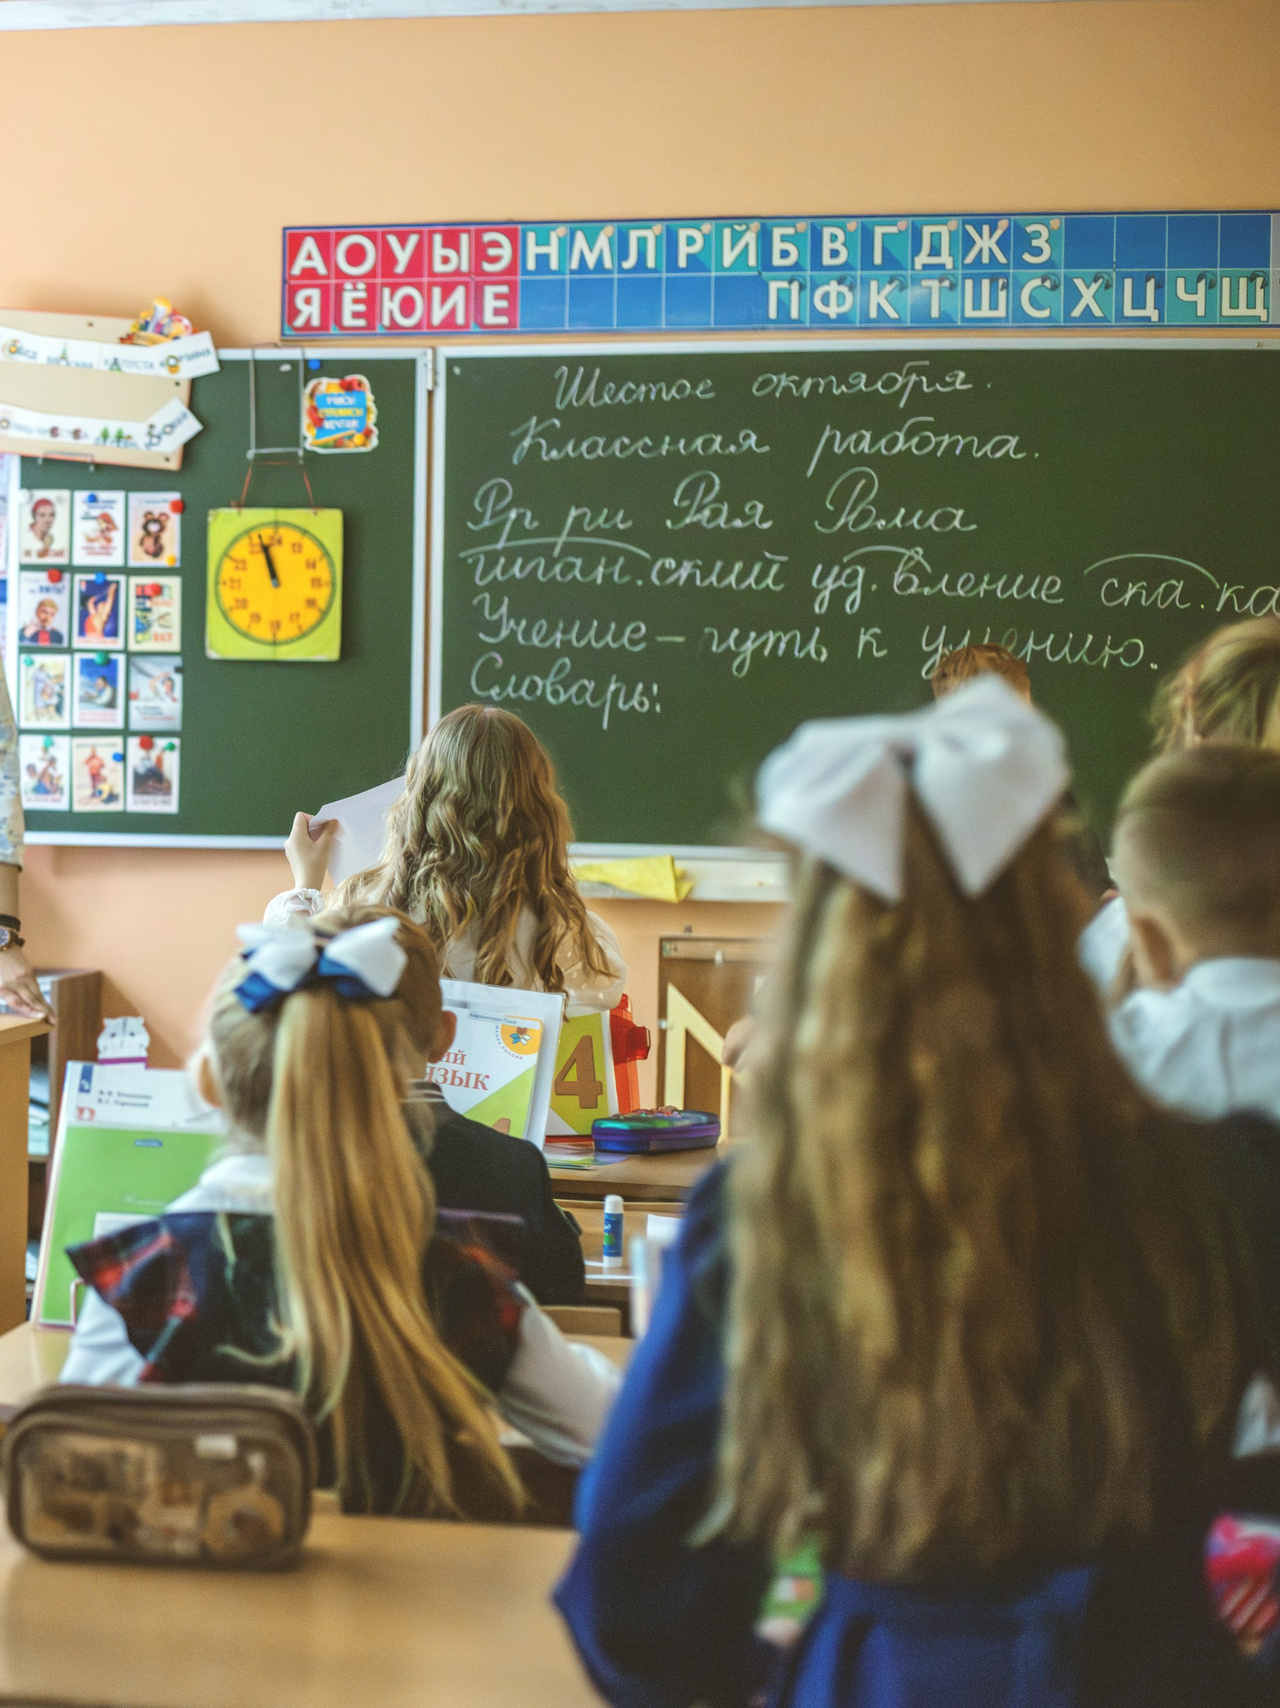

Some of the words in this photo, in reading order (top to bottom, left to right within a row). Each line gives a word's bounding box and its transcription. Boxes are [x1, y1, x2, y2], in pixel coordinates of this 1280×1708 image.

[290, 236, 327, 275] А
[336, 234, 376, 275] О
[386, 234, 419, 274] У
[433, 233, 469, 273] Ы
[481, 231, 512, 273] Э
[526, 231, 559, 271] Н
[570, 230, 613, 270] М
[621, 229, 656, 269] Л
[678, 228, 705, 268] Р
[723, 224, 757, 268] Й
[772, 226, 799, 267] Б
[822, 225, 849, 266] В
[914, 224, 953, 270] Д
[964, 223, 1009, 264] Ж
[292, 287, 321, 327] Я
[343, 283, 368, 327] Ё
[383, 286, 424, 326] Ю
[431, 286, 466, 325] И
[484, 285, 509, 324] Е
[768, 279, 800, 320] П
[813, 279, 854, 320] Ф
[869, 279, 900, 320] К
[921, 278, 952, 318] Т
[964, 278, 1008, 318] Ш
[1021, 278, 1052, 318] С
[1124, 277, 1159, 322] Ц
[1176, 276, 1207, 317] Ч
[1221, 276, 1268, 322] Щ
[554, 365, 716, 411] Шестое
[510, 416, 770, 465] Классная
[807, 417, 1039, 477] работа.
[471, 651, 661, 731] Словарь:
[554, 1035, 603, 1109] 4
